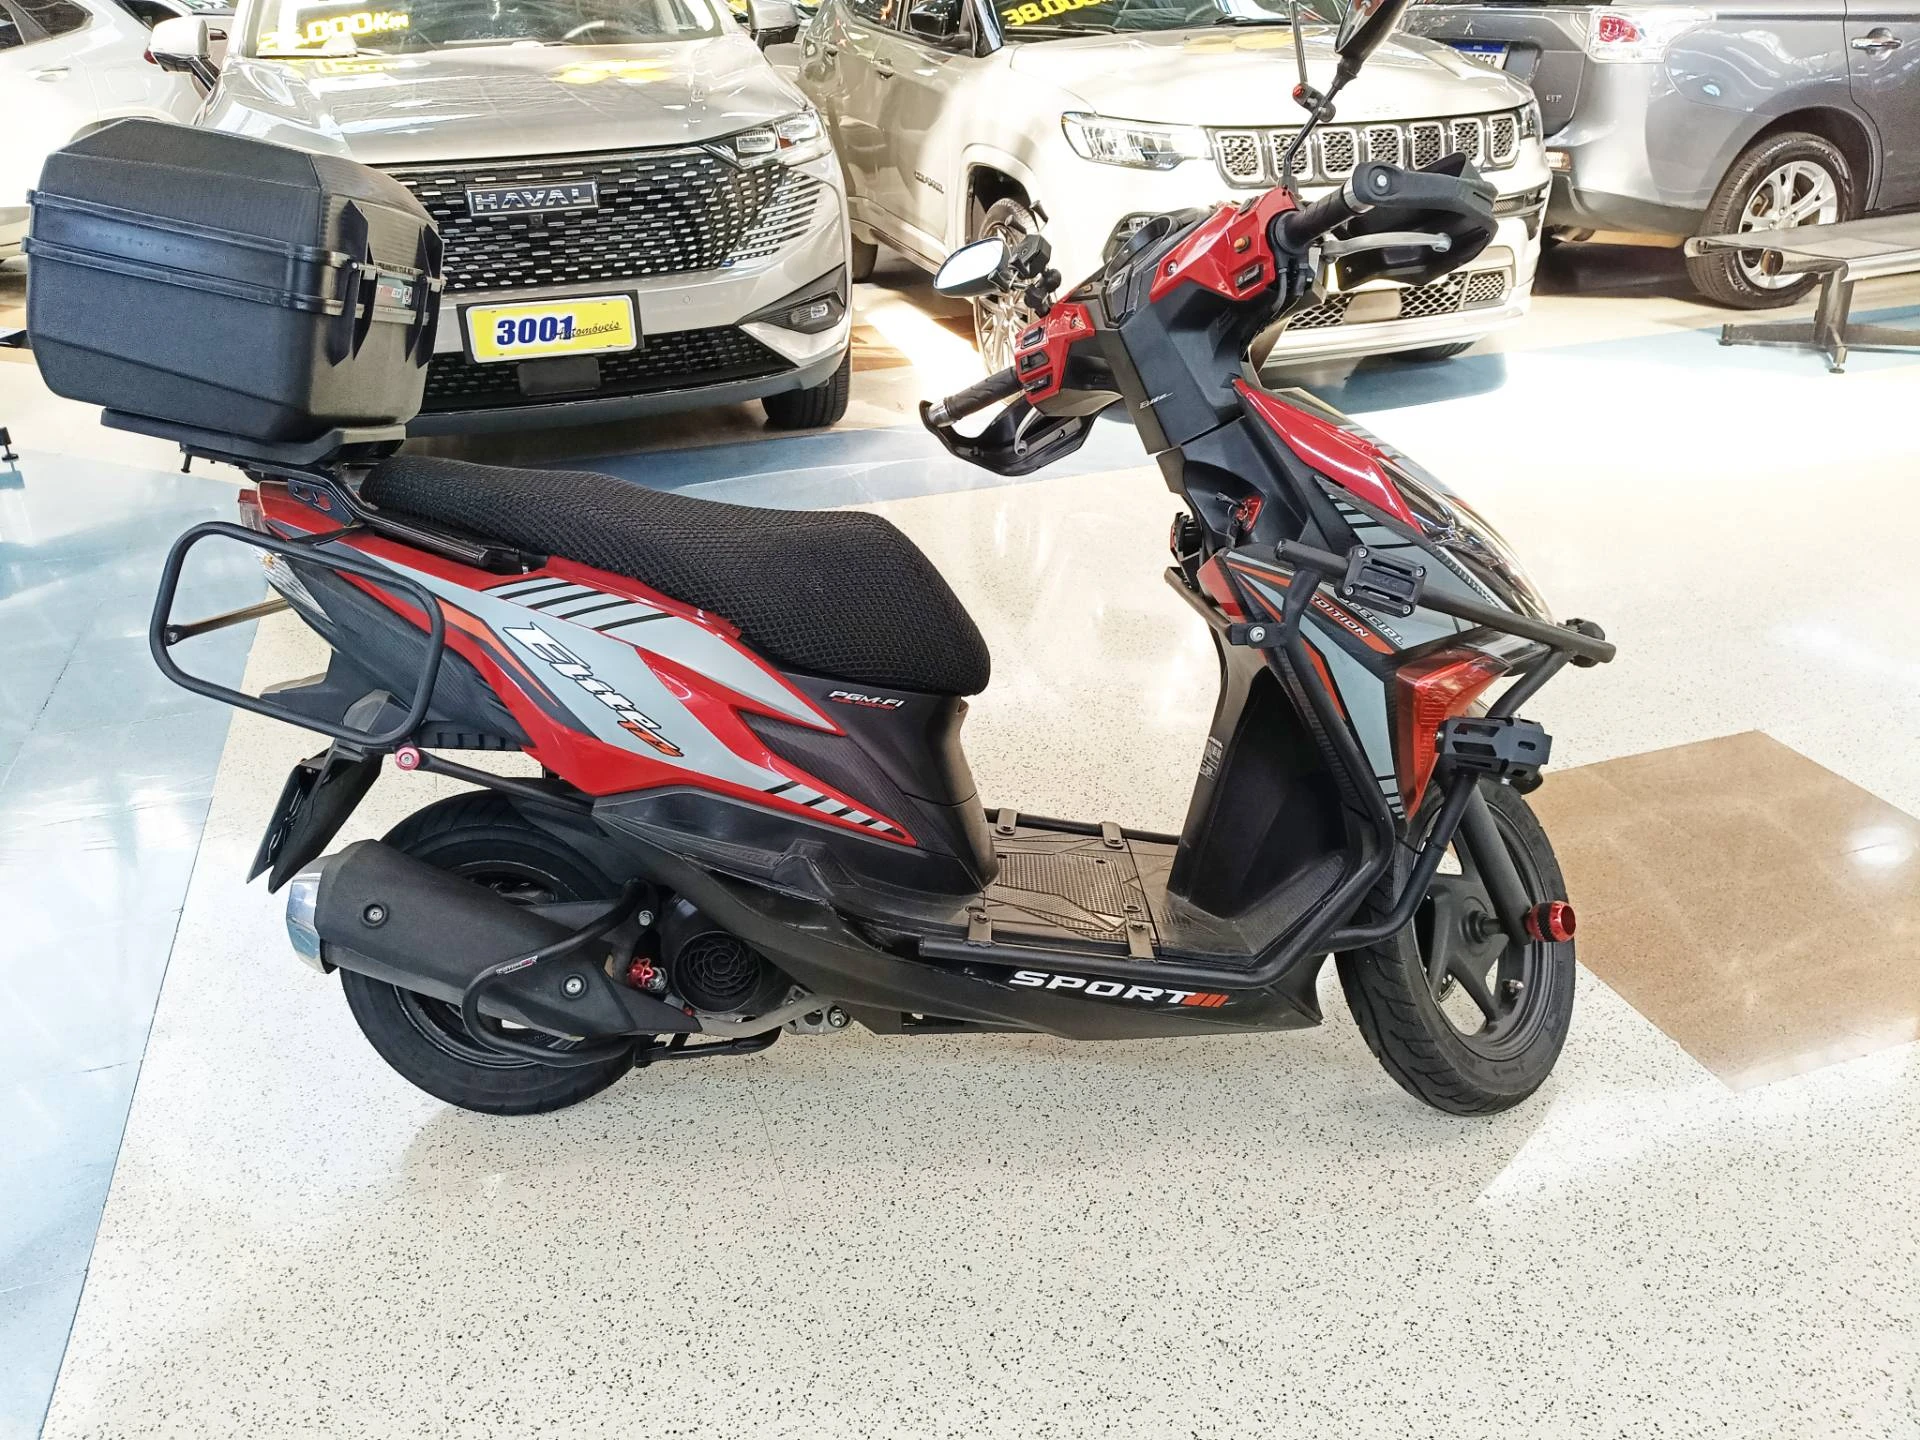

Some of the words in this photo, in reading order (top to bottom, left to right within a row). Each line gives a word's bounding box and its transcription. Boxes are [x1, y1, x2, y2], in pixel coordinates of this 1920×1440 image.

[474, 187, 592, 211] HAVAL
[496, 315, 574, 346] 3001
[502, 621, 681, 752] Elite
[1008, 969, 1197, 1004] SPORT
